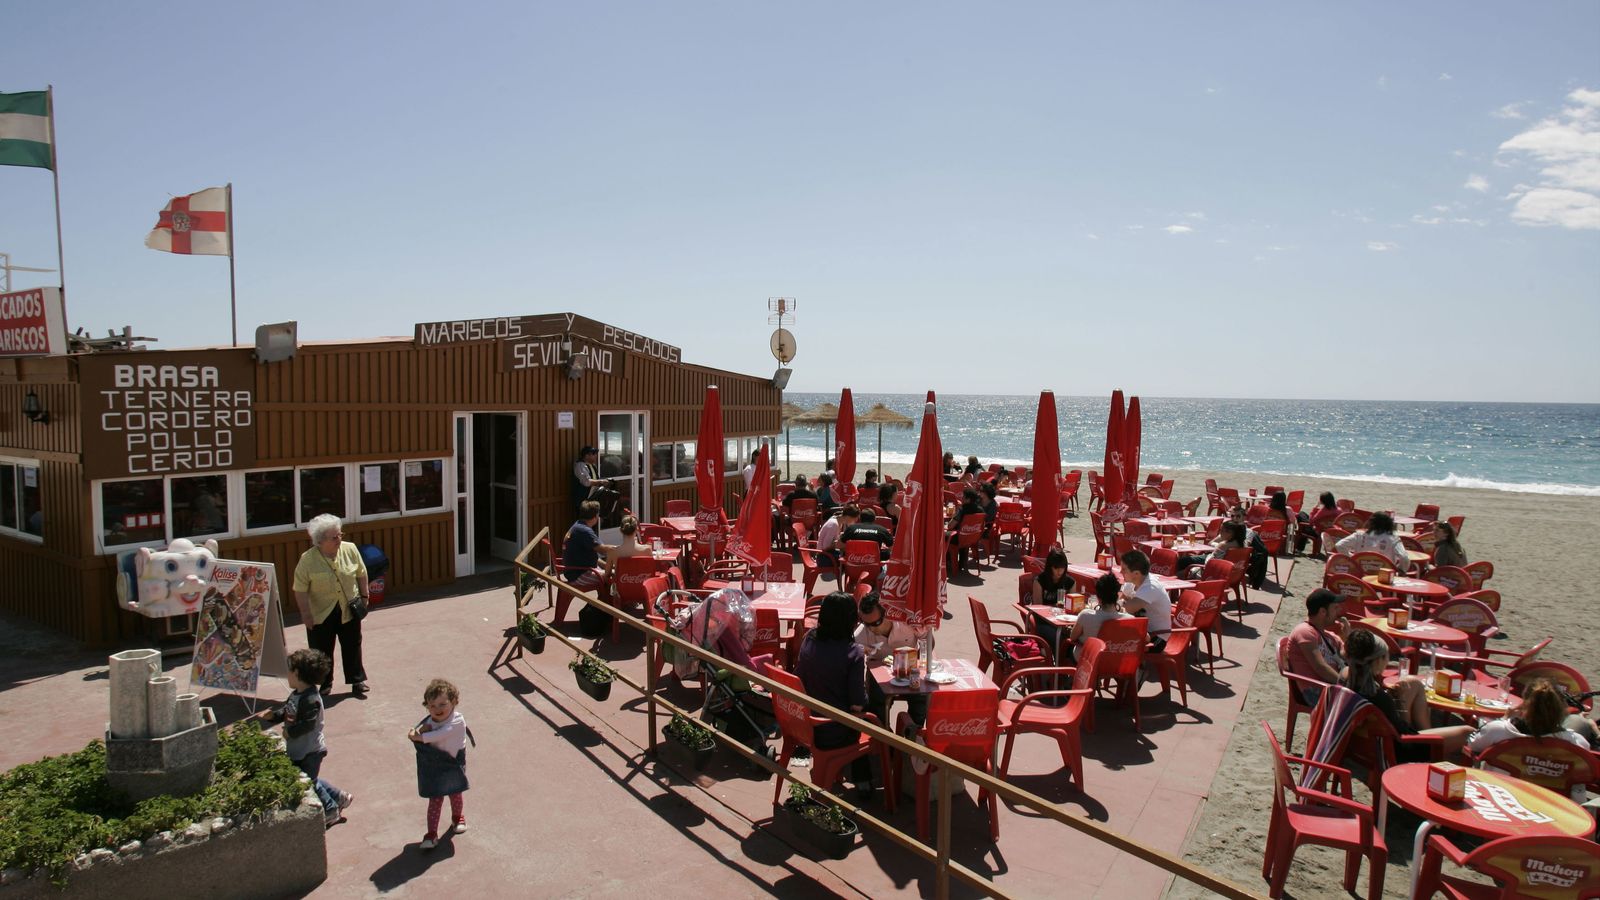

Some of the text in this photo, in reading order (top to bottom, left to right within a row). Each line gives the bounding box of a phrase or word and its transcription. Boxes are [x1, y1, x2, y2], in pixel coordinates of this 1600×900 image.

[0, 293, 42, 320] CADOS
[421, 314, 679, 363] MARISCOS Y PESCADOS
[115, 365, 219, 388] BRASA
[101, 390, 251, 409] TERNERA
[102, 410, 251, 431] CORDERO
[127, 430, 232, 451] POLLO
[128, 449, 233, 473] CERDO
[210, 566, 238, 582] Kalise
[1525, 756, 1569, 770] Mahou
[1526, 859, 1584, 878] Mahou
